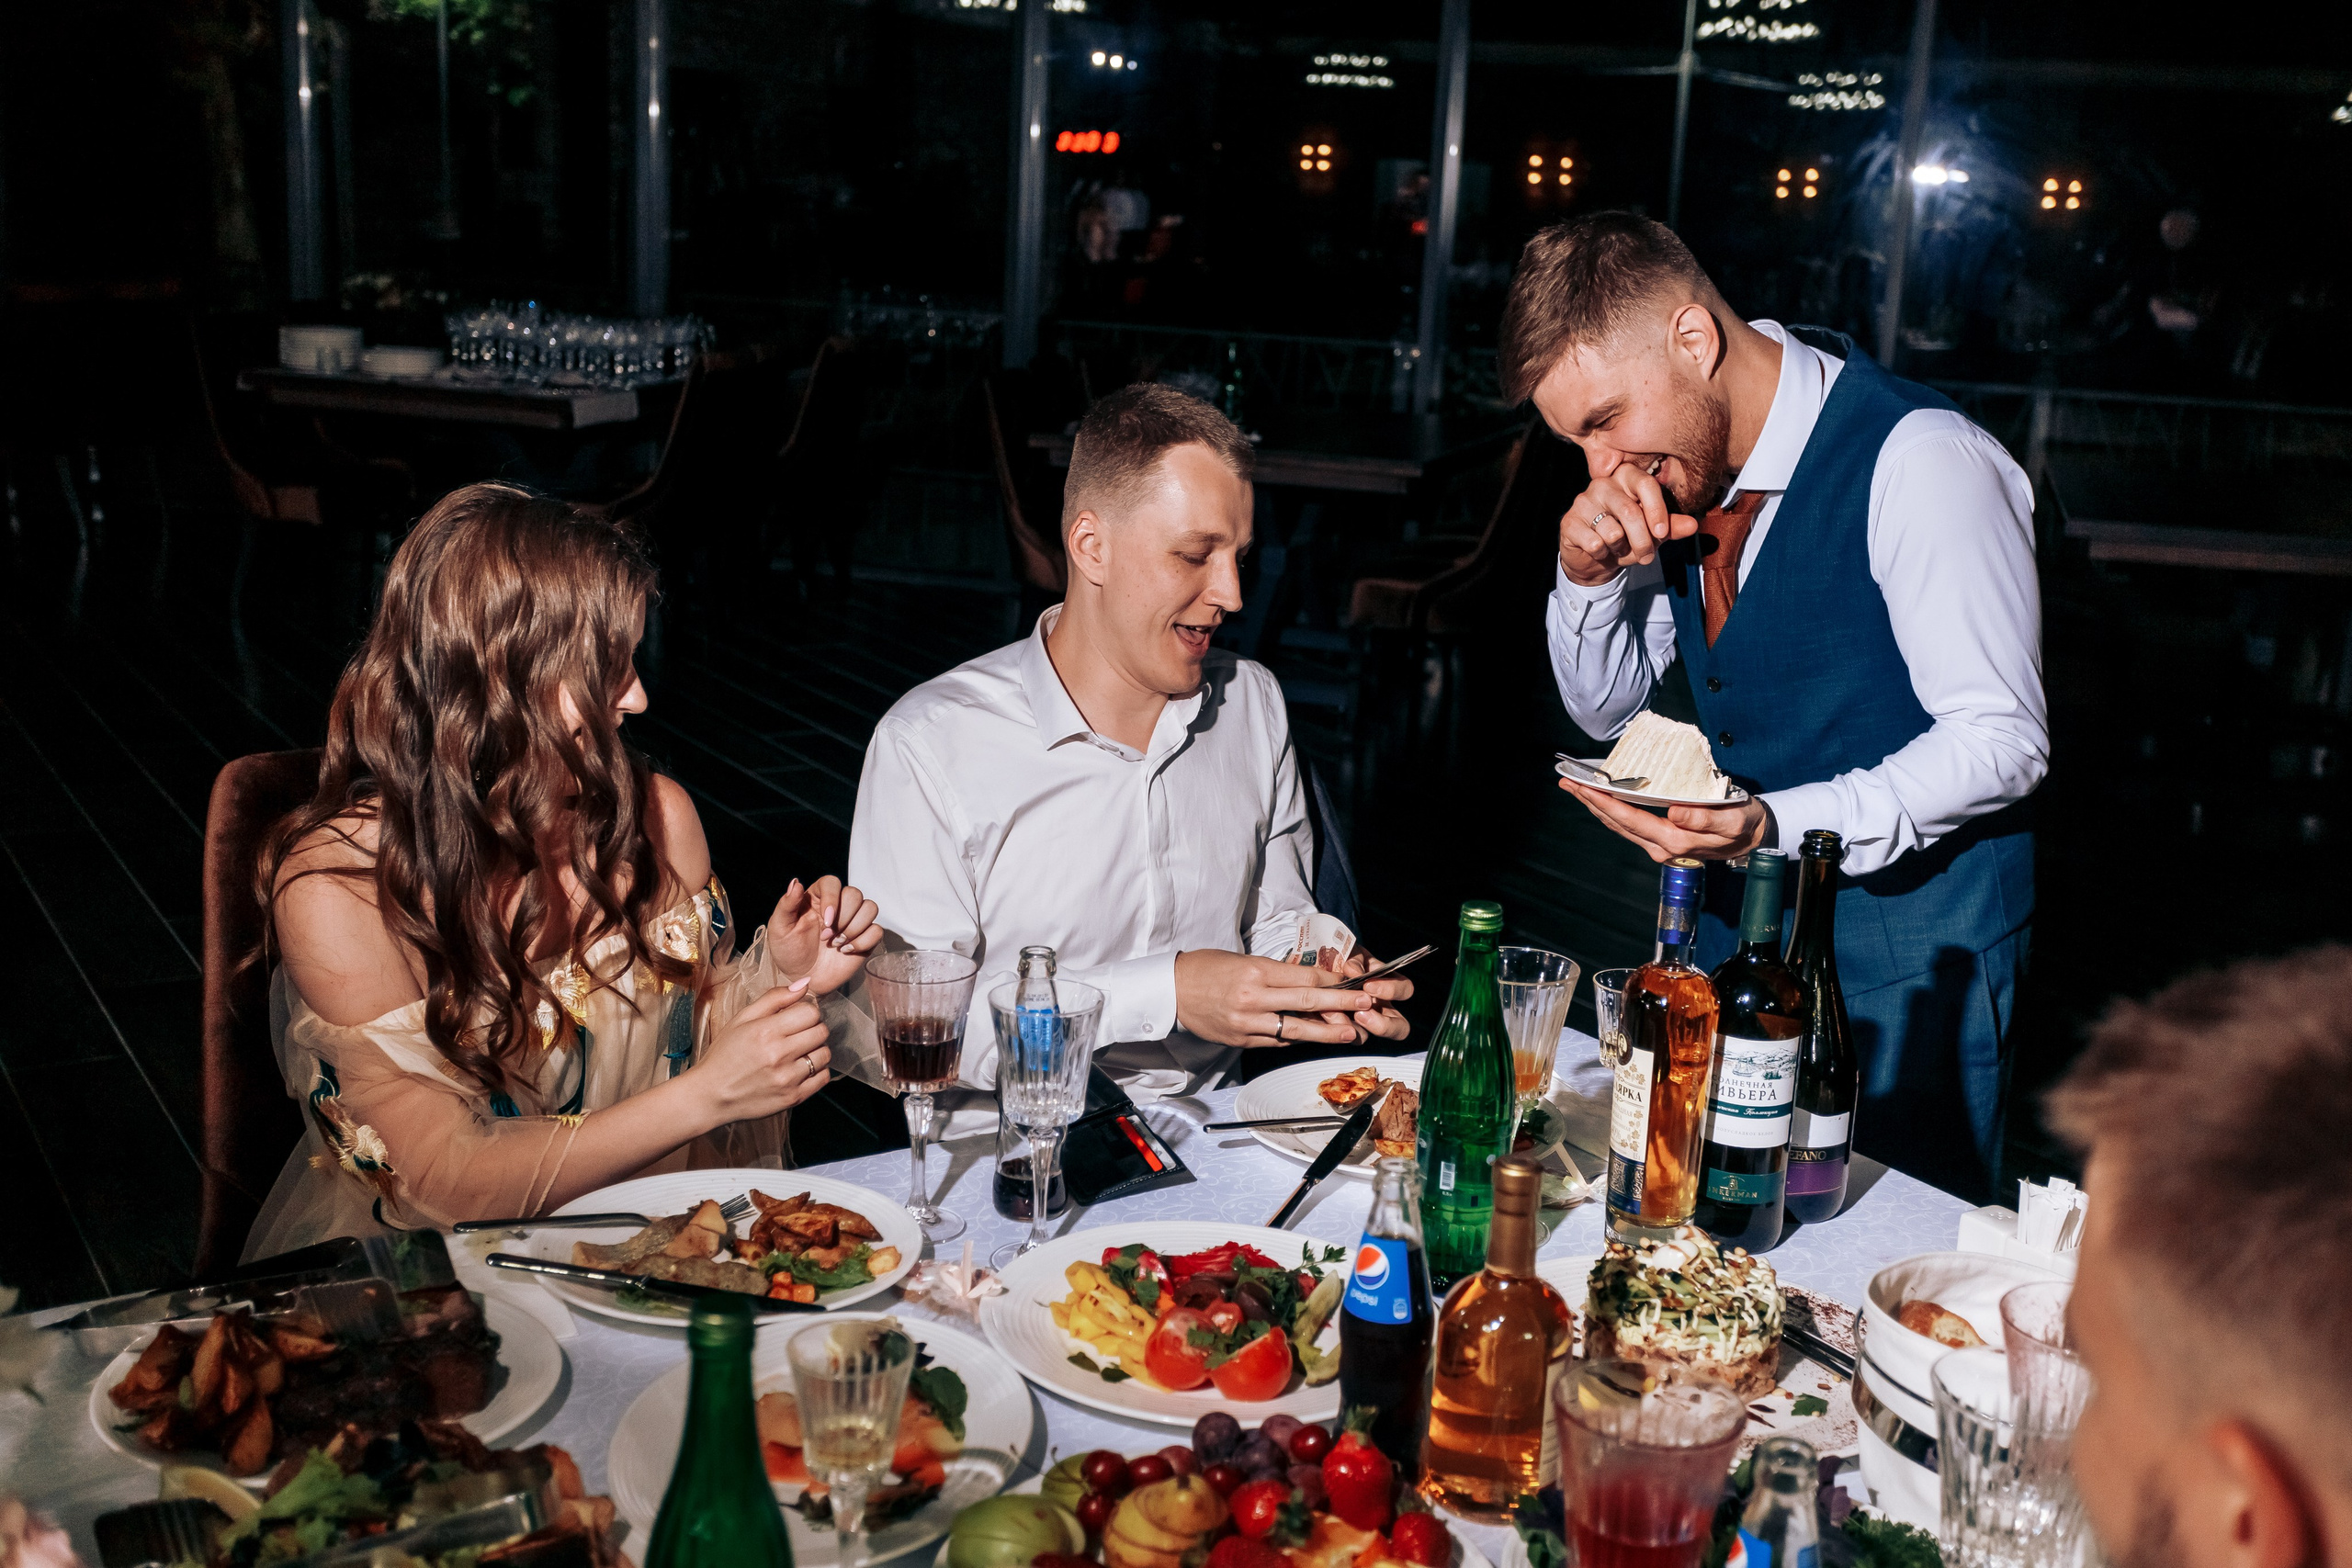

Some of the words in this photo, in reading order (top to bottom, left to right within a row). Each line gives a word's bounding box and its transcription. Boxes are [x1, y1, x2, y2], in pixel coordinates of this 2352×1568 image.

[1714, 1084, 1777, 1100] ИВЬЕРА
[1790, 1150, 1827, 1161] EFANO
[1350, 1288, 1378, 1307] pepsi
